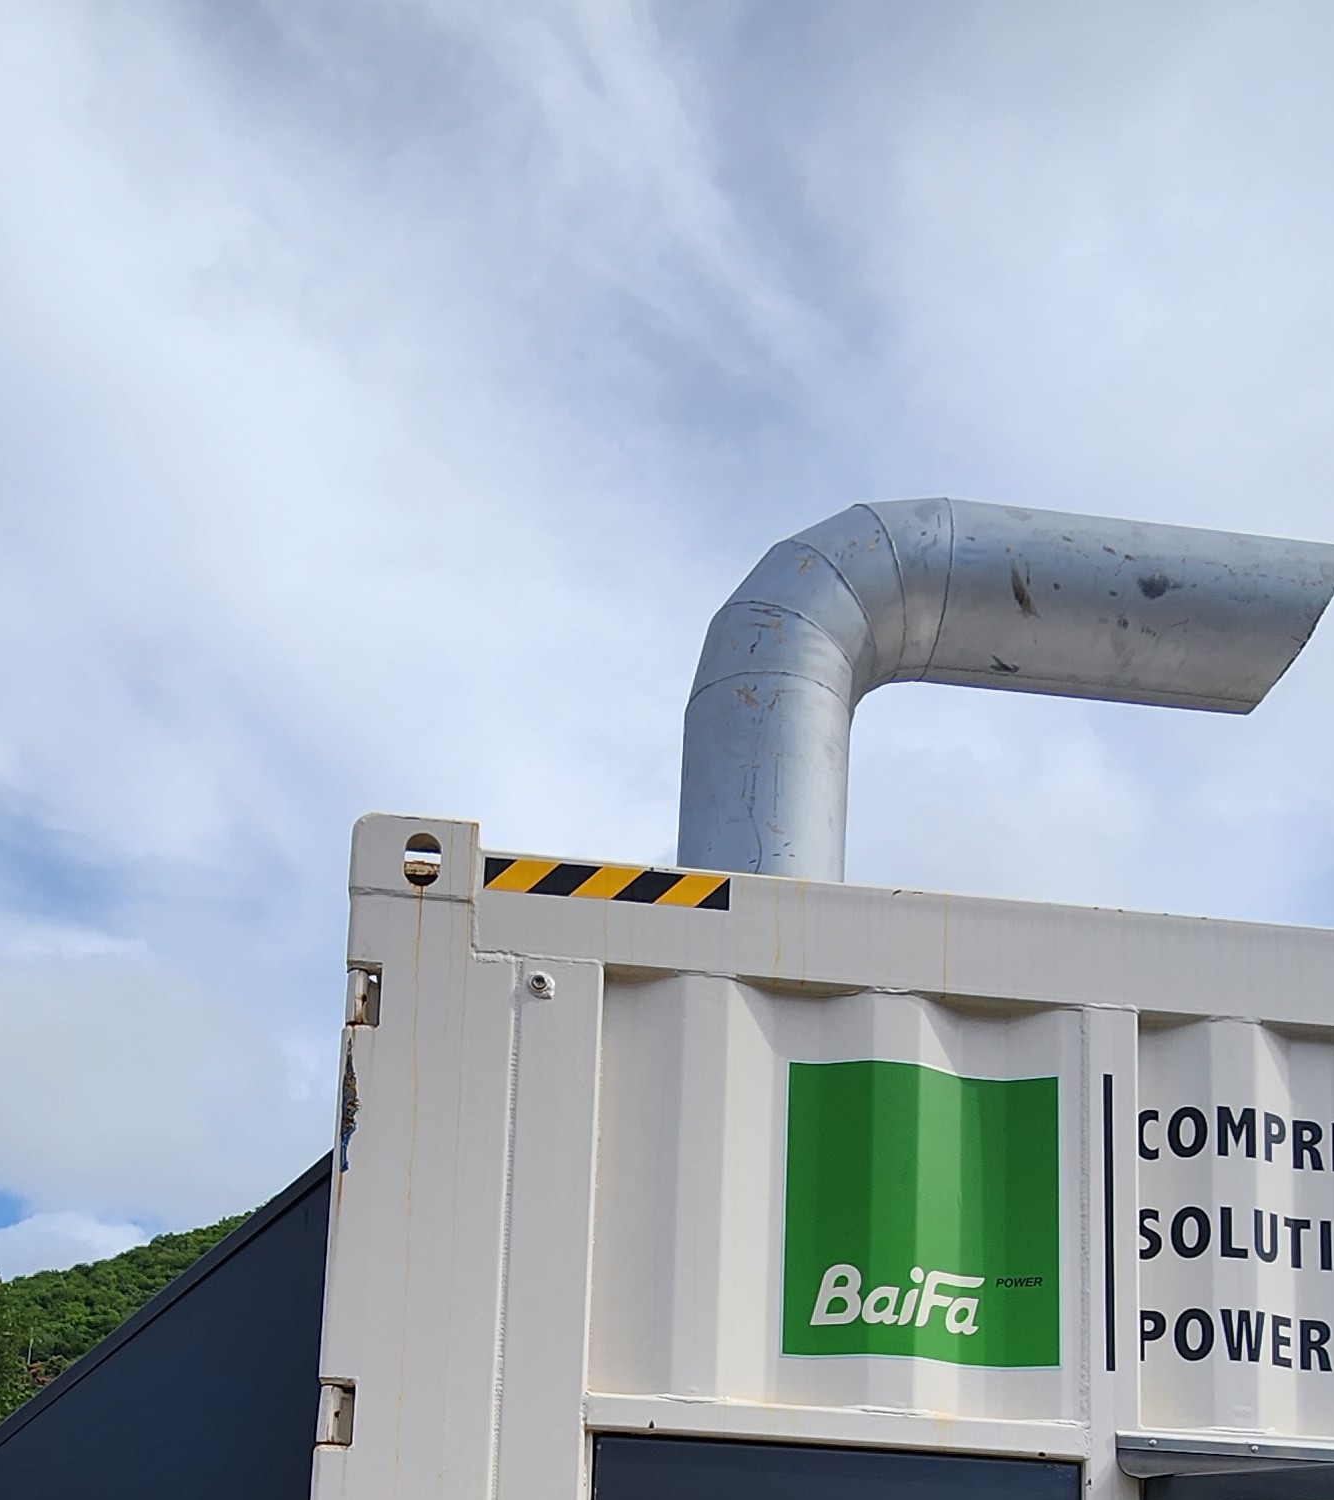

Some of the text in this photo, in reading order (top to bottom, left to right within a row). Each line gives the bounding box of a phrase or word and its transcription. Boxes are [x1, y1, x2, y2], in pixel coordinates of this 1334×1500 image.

[809, 1263, 1043, 1335] BaiFa POWER
[1139, 1308, 1333, 1372] POWER
